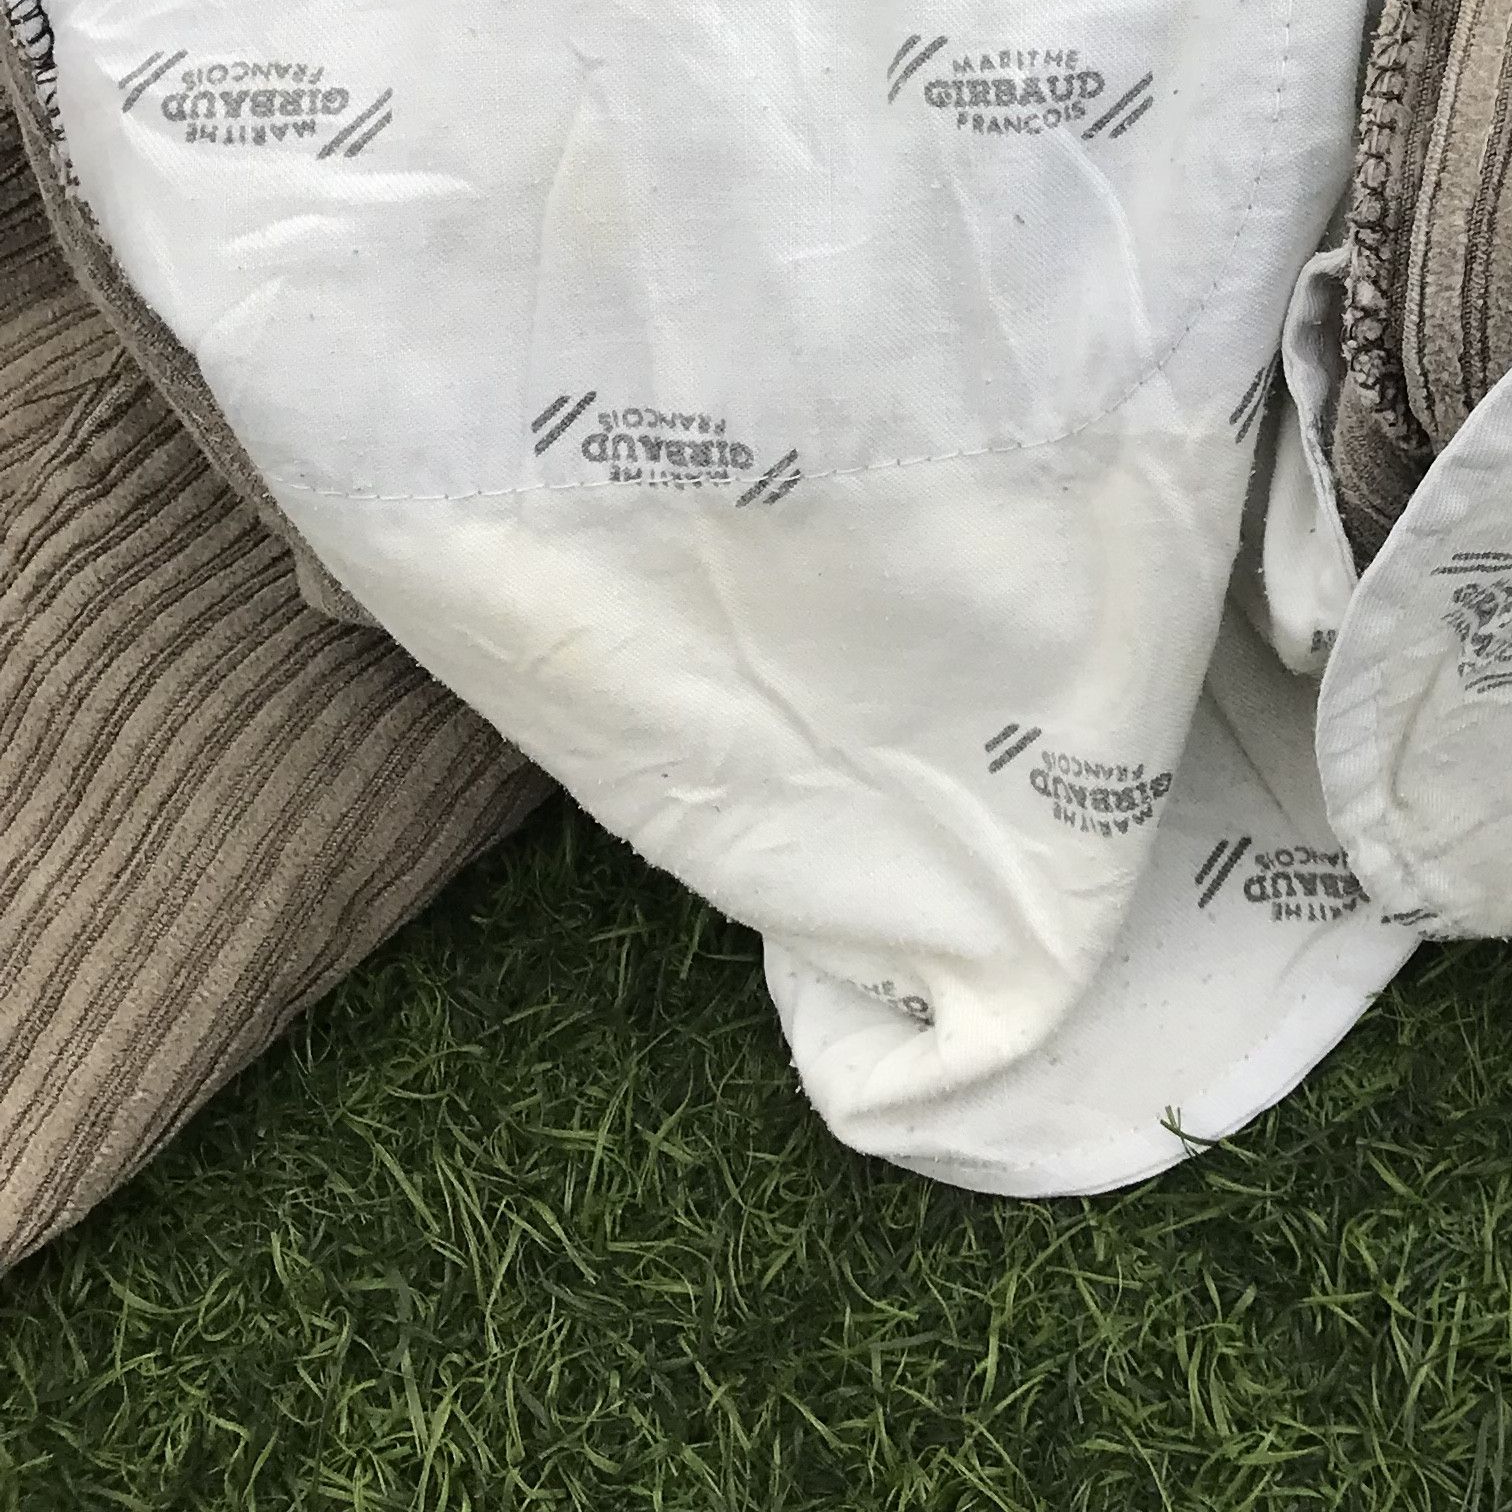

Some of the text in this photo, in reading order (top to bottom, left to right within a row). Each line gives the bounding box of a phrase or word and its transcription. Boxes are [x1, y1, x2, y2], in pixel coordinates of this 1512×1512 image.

[952, 48, 1081, 75] MARITHE
[161, 87, 350, 122] GIRBAUD
[923, 70, 1106, 108] GIRBAUD
[185, 118, 317, 146] MARITHE
[581, 432, 755, 470] GIRBAUD
[1029, 767, 1173, 813] GIRBAUD
